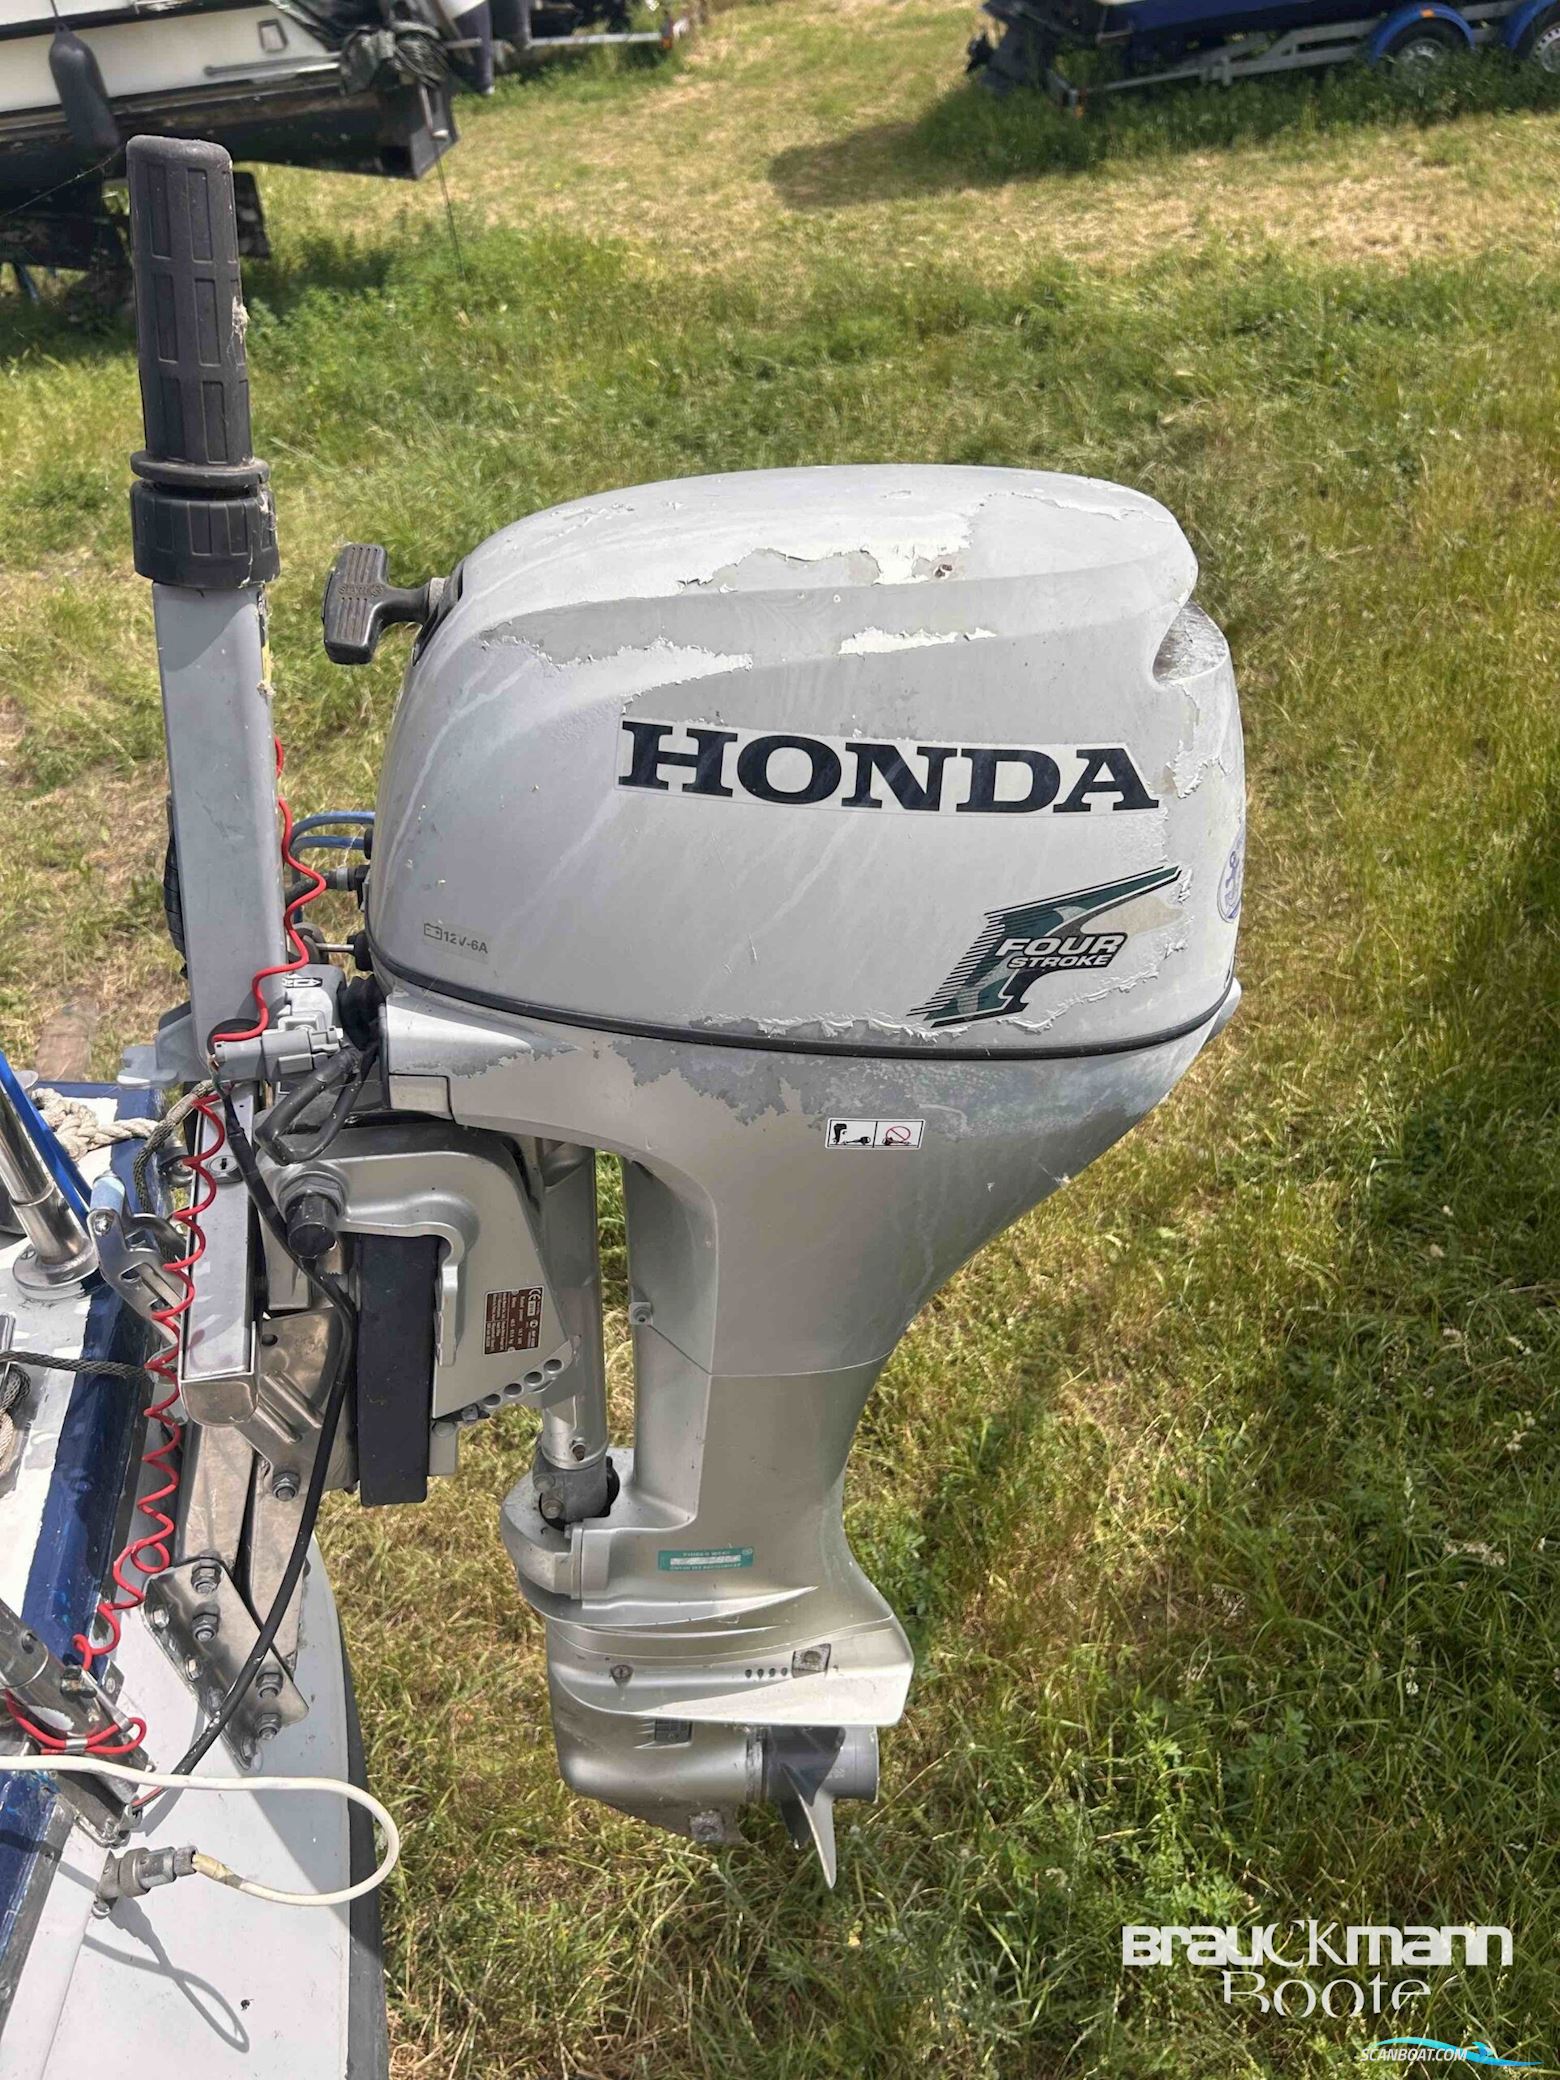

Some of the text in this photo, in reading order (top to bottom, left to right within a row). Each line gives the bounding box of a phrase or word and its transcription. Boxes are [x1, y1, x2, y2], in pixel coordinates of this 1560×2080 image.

[618, 720, 1159, 812] HONDA
[443, 931, 488, 954] 12V-6A
[995, 934, 1124, 957] FOUR
[1007, 955, 1109, 969] STROKE
